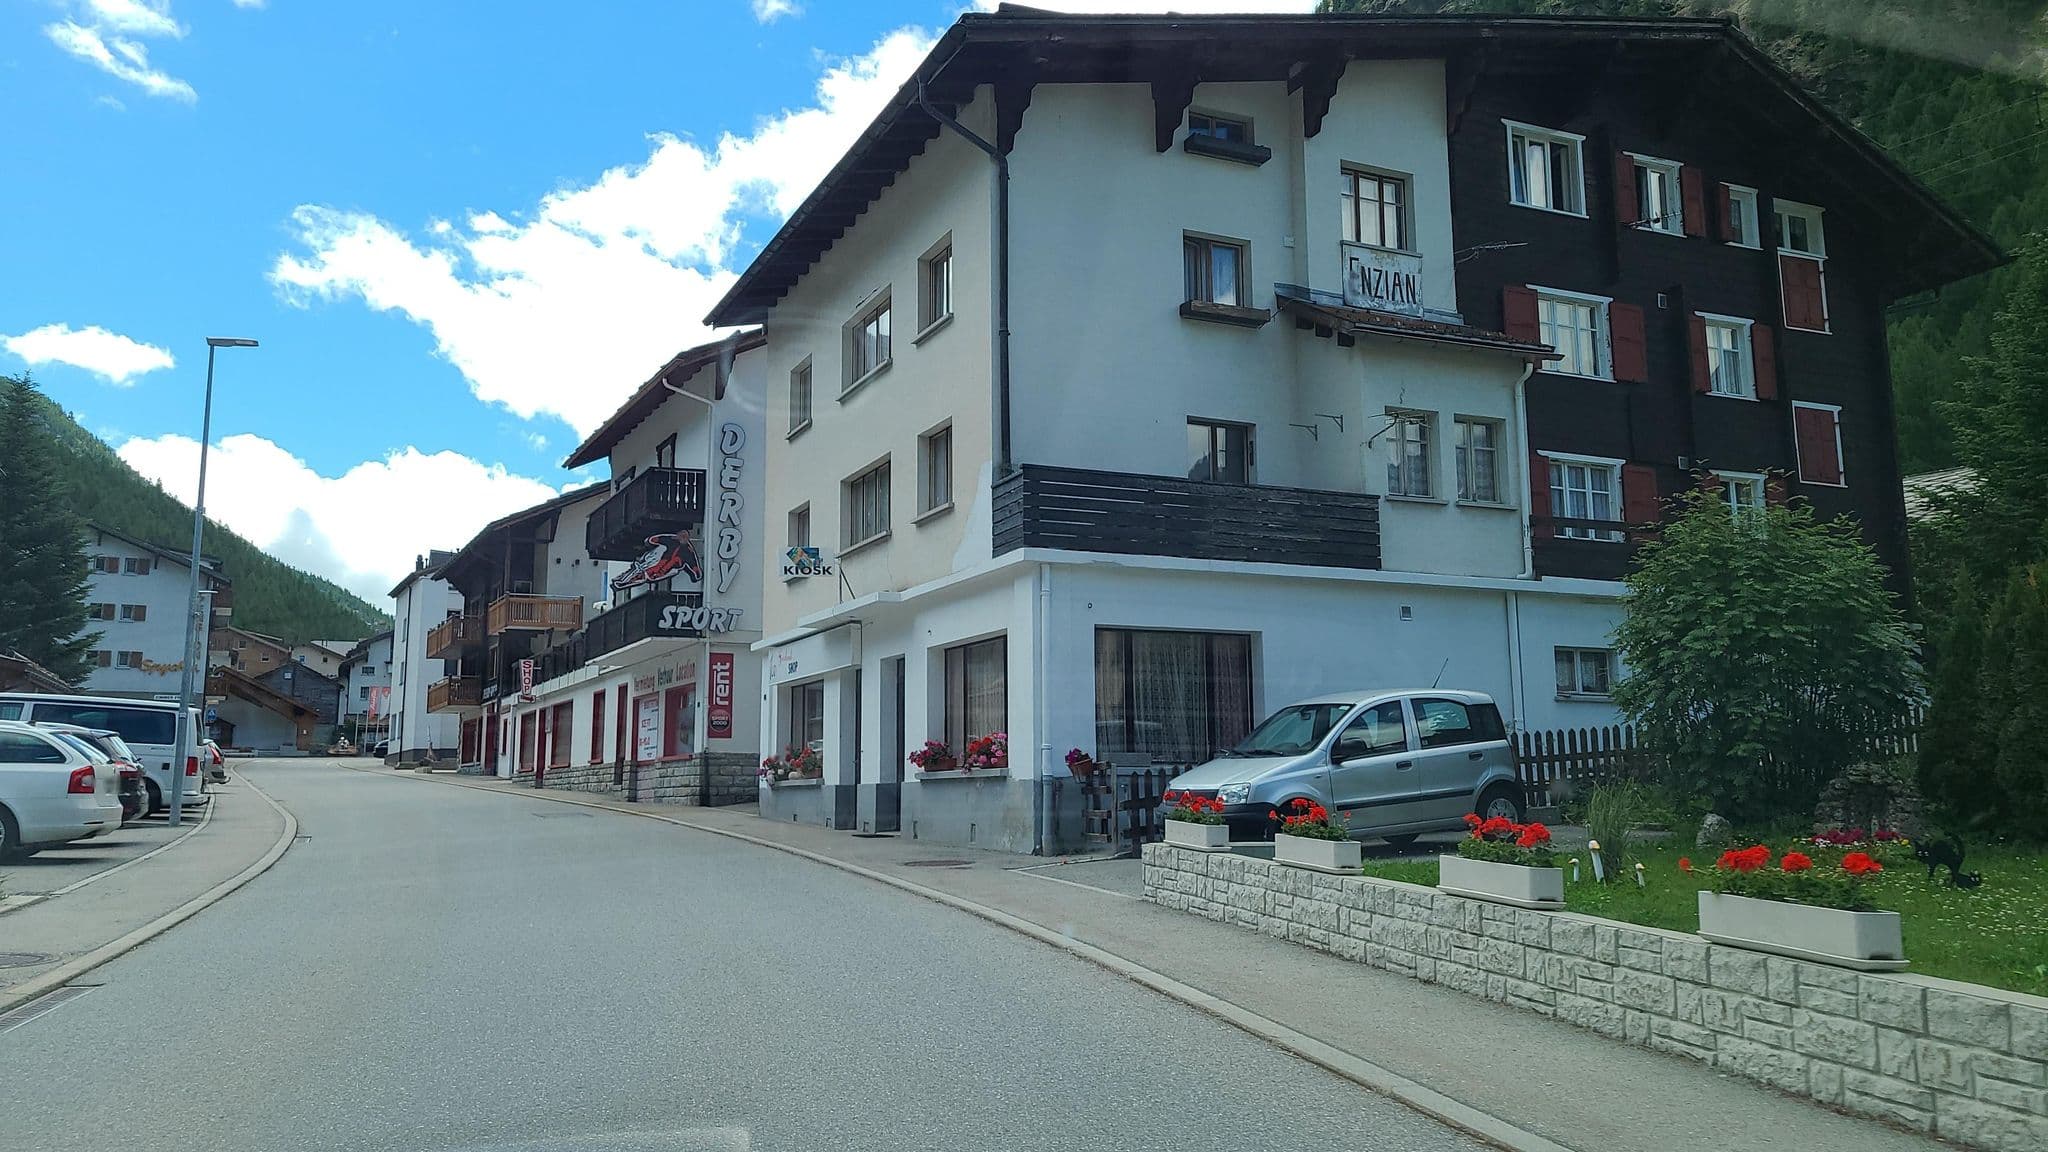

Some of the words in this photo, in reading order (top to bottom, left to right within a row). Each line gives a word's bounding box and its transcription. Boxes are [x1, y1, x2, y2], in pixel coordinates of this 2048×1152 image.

[717, 423, 746, 593] DERBY
[783, 565, 833, 575] KIOSK
[658, 606, 744, 633] SPORT
[522, 660, 532, 692] SHOP
[713, 662, 730, 705] rent
